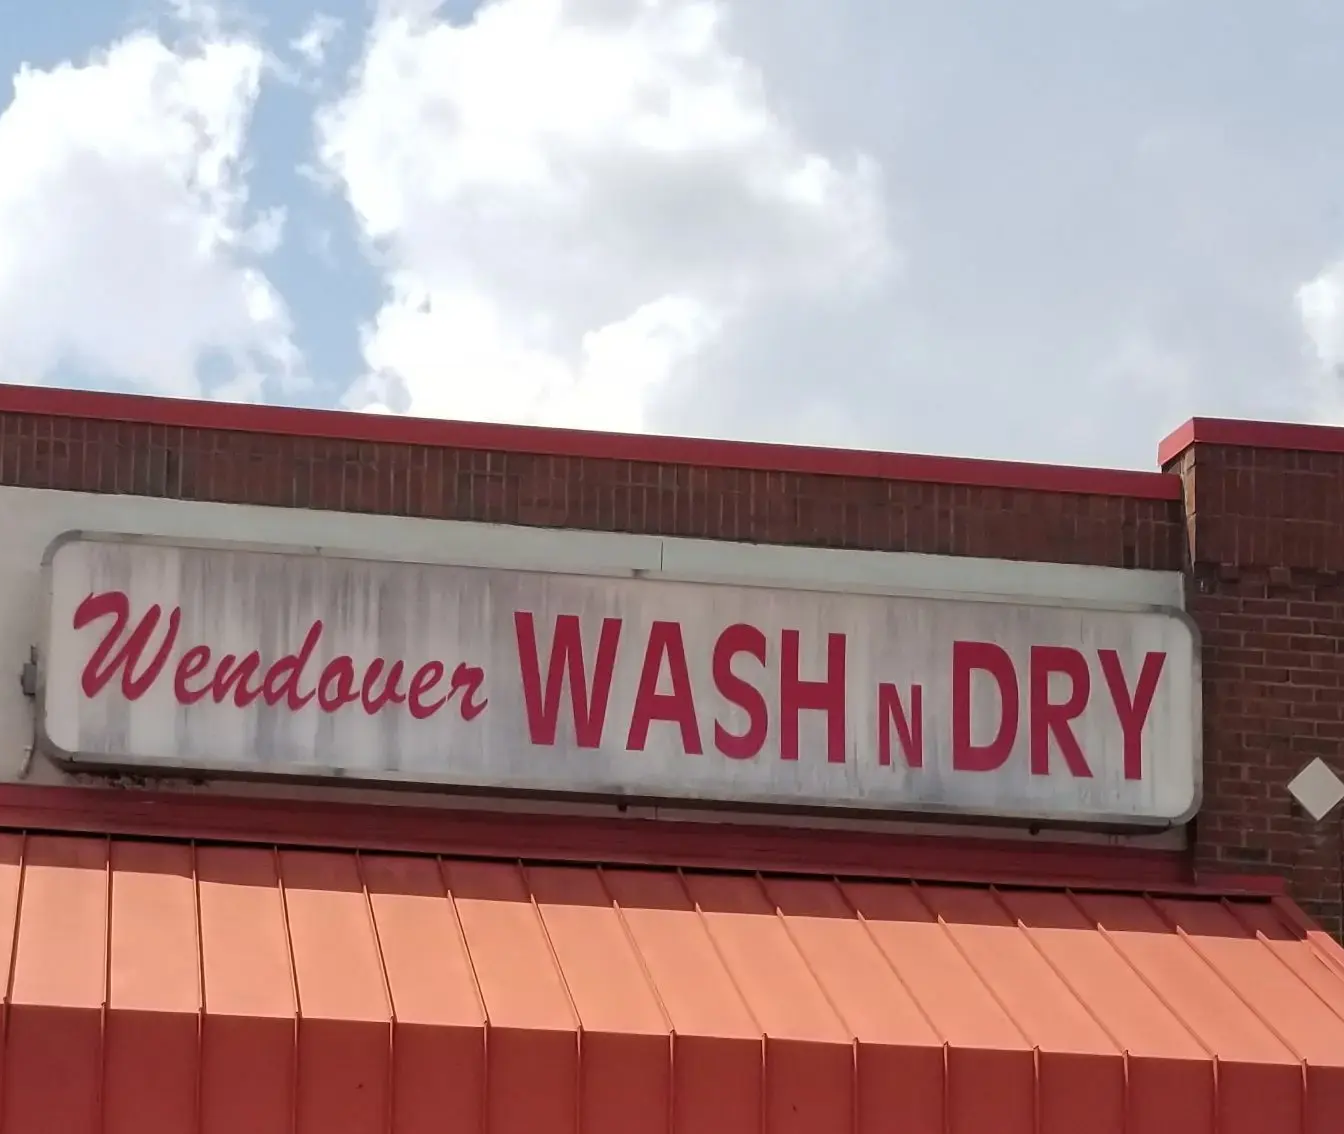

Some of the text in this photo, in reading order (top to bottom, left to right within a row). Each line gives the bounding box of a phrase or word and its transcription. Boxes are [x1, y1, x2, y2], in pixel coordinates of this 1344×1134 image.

[73, 591, 1167, 780] Wendover WASH N DRY
